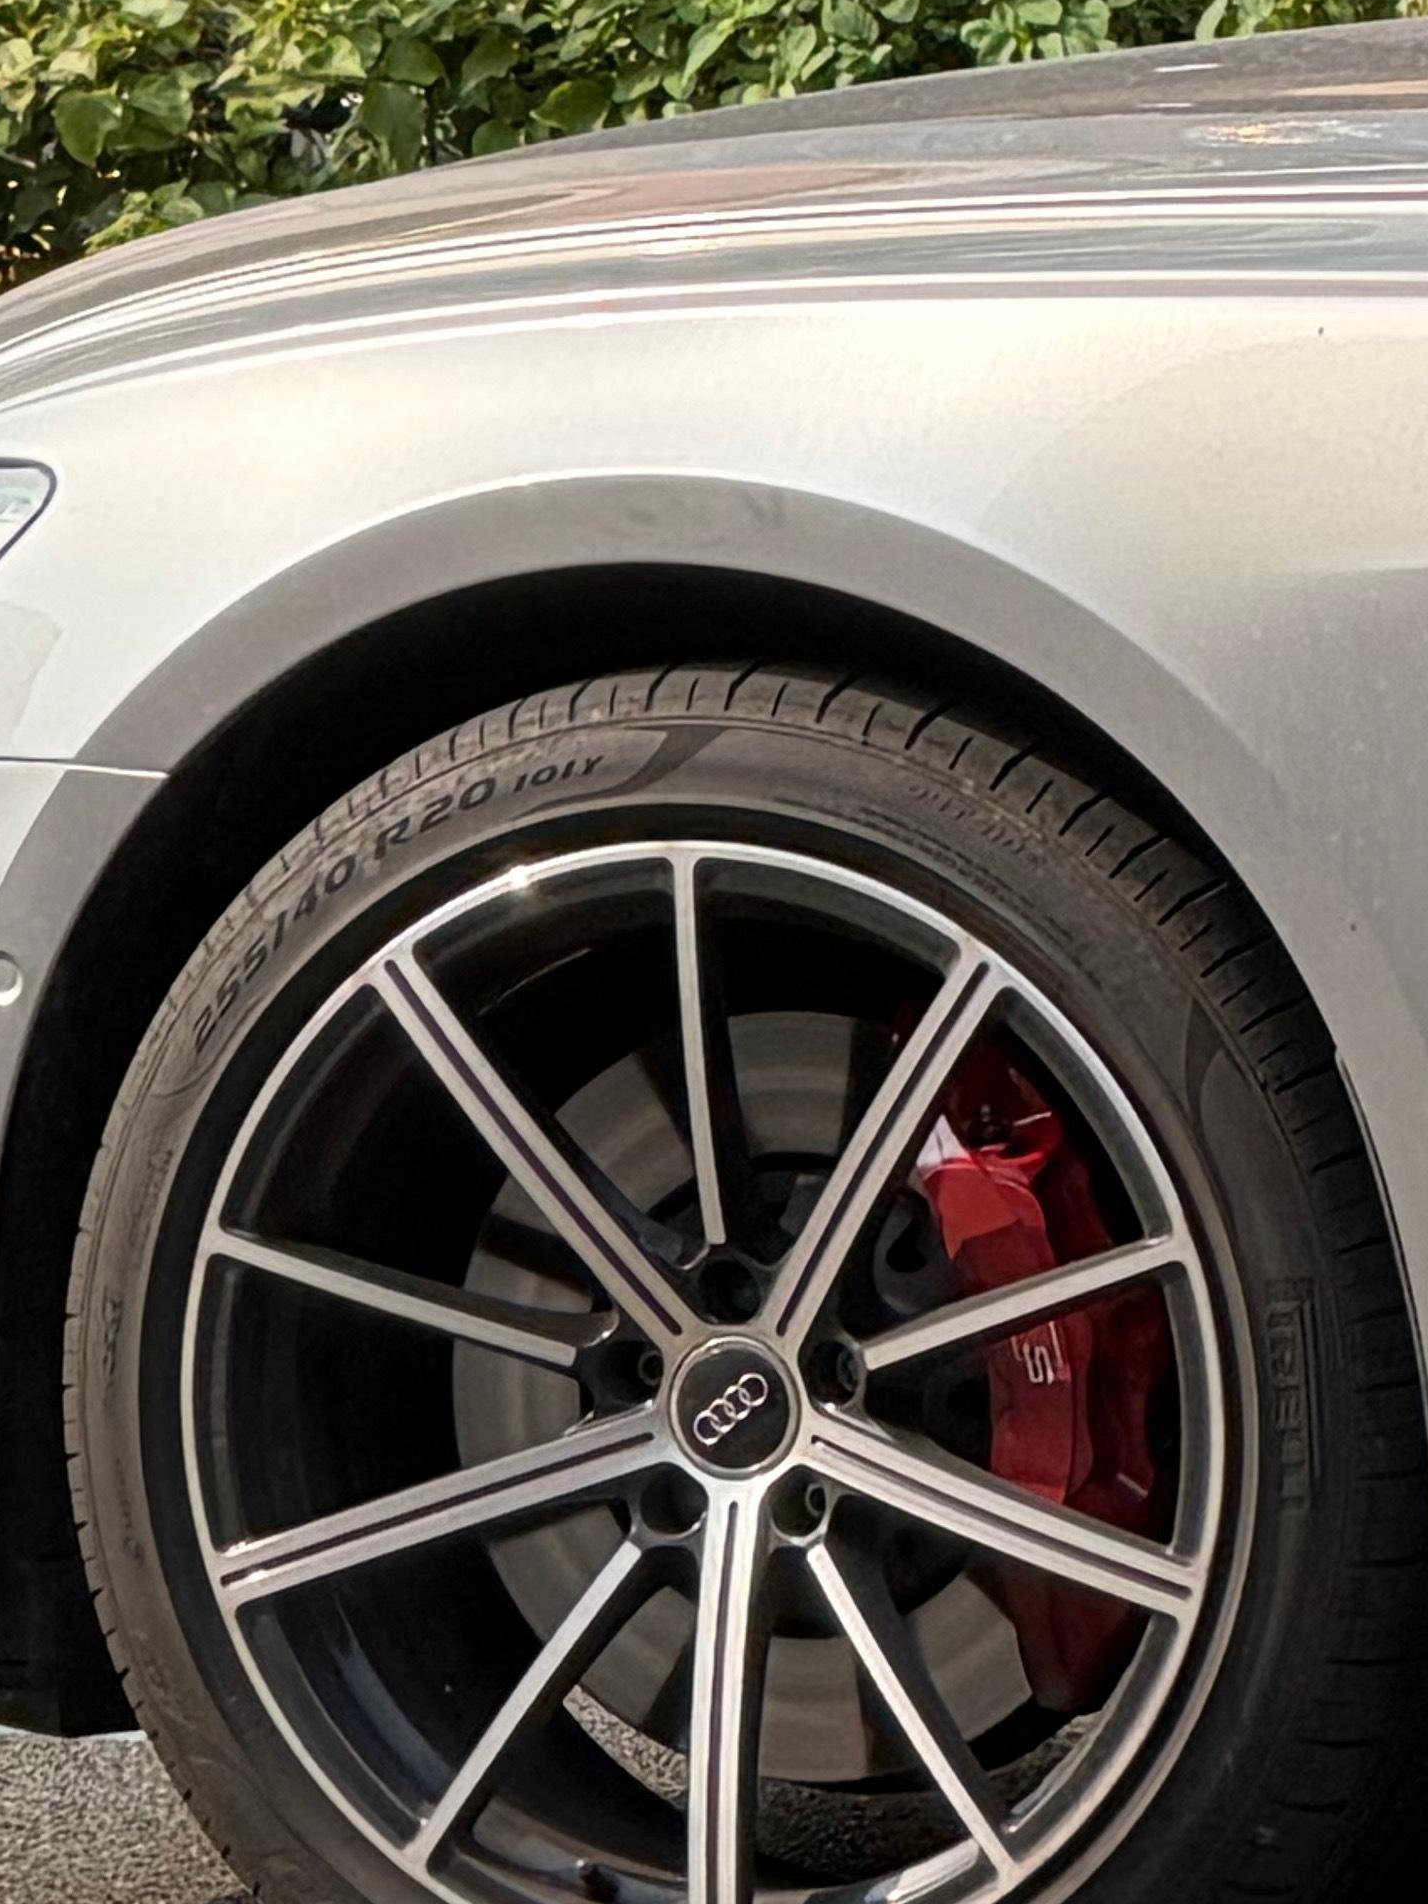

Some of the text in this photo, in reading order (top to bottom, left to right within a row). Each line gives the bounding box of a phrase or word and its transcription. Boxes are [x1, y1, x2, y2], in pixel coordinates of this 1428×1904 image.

[192, 754, 605, 1053] 255/40 R20 101Y
